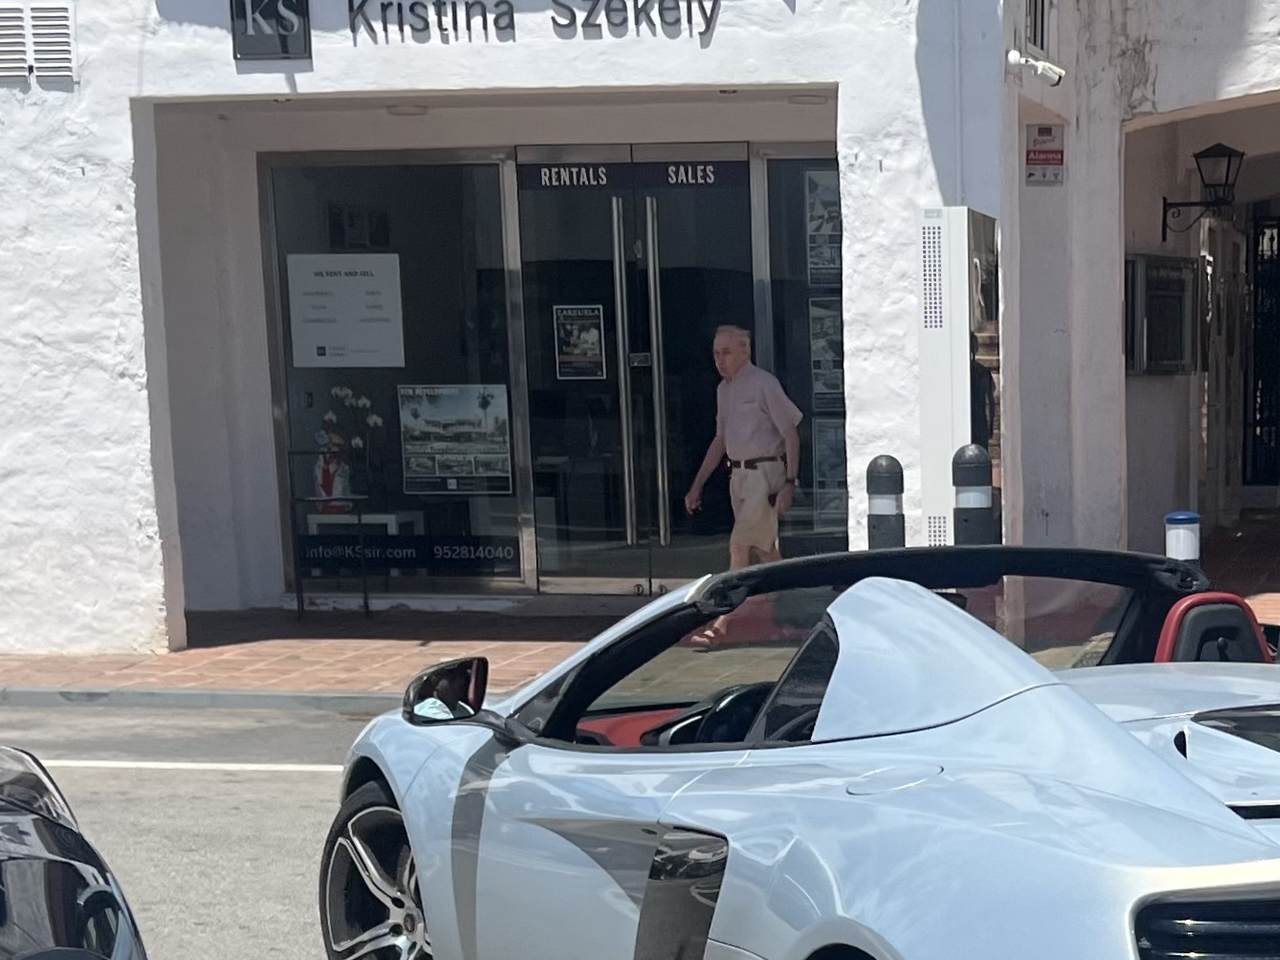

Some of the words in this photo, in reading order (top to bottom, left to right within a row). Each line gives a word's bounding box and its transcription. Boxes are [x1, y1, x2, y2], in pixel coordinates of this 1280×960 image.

[244, 0, 299, 36] KS
[350, 0, 515, 35] Kristina
[551, 0, 718, 36] Szekely
[540, 166, 607, 186] RENTALS
[667, 165, 715, 184] SALES
[305, 545, 416, 559] info@KSsir.com
[433, 545, 514, 559] 952814040
